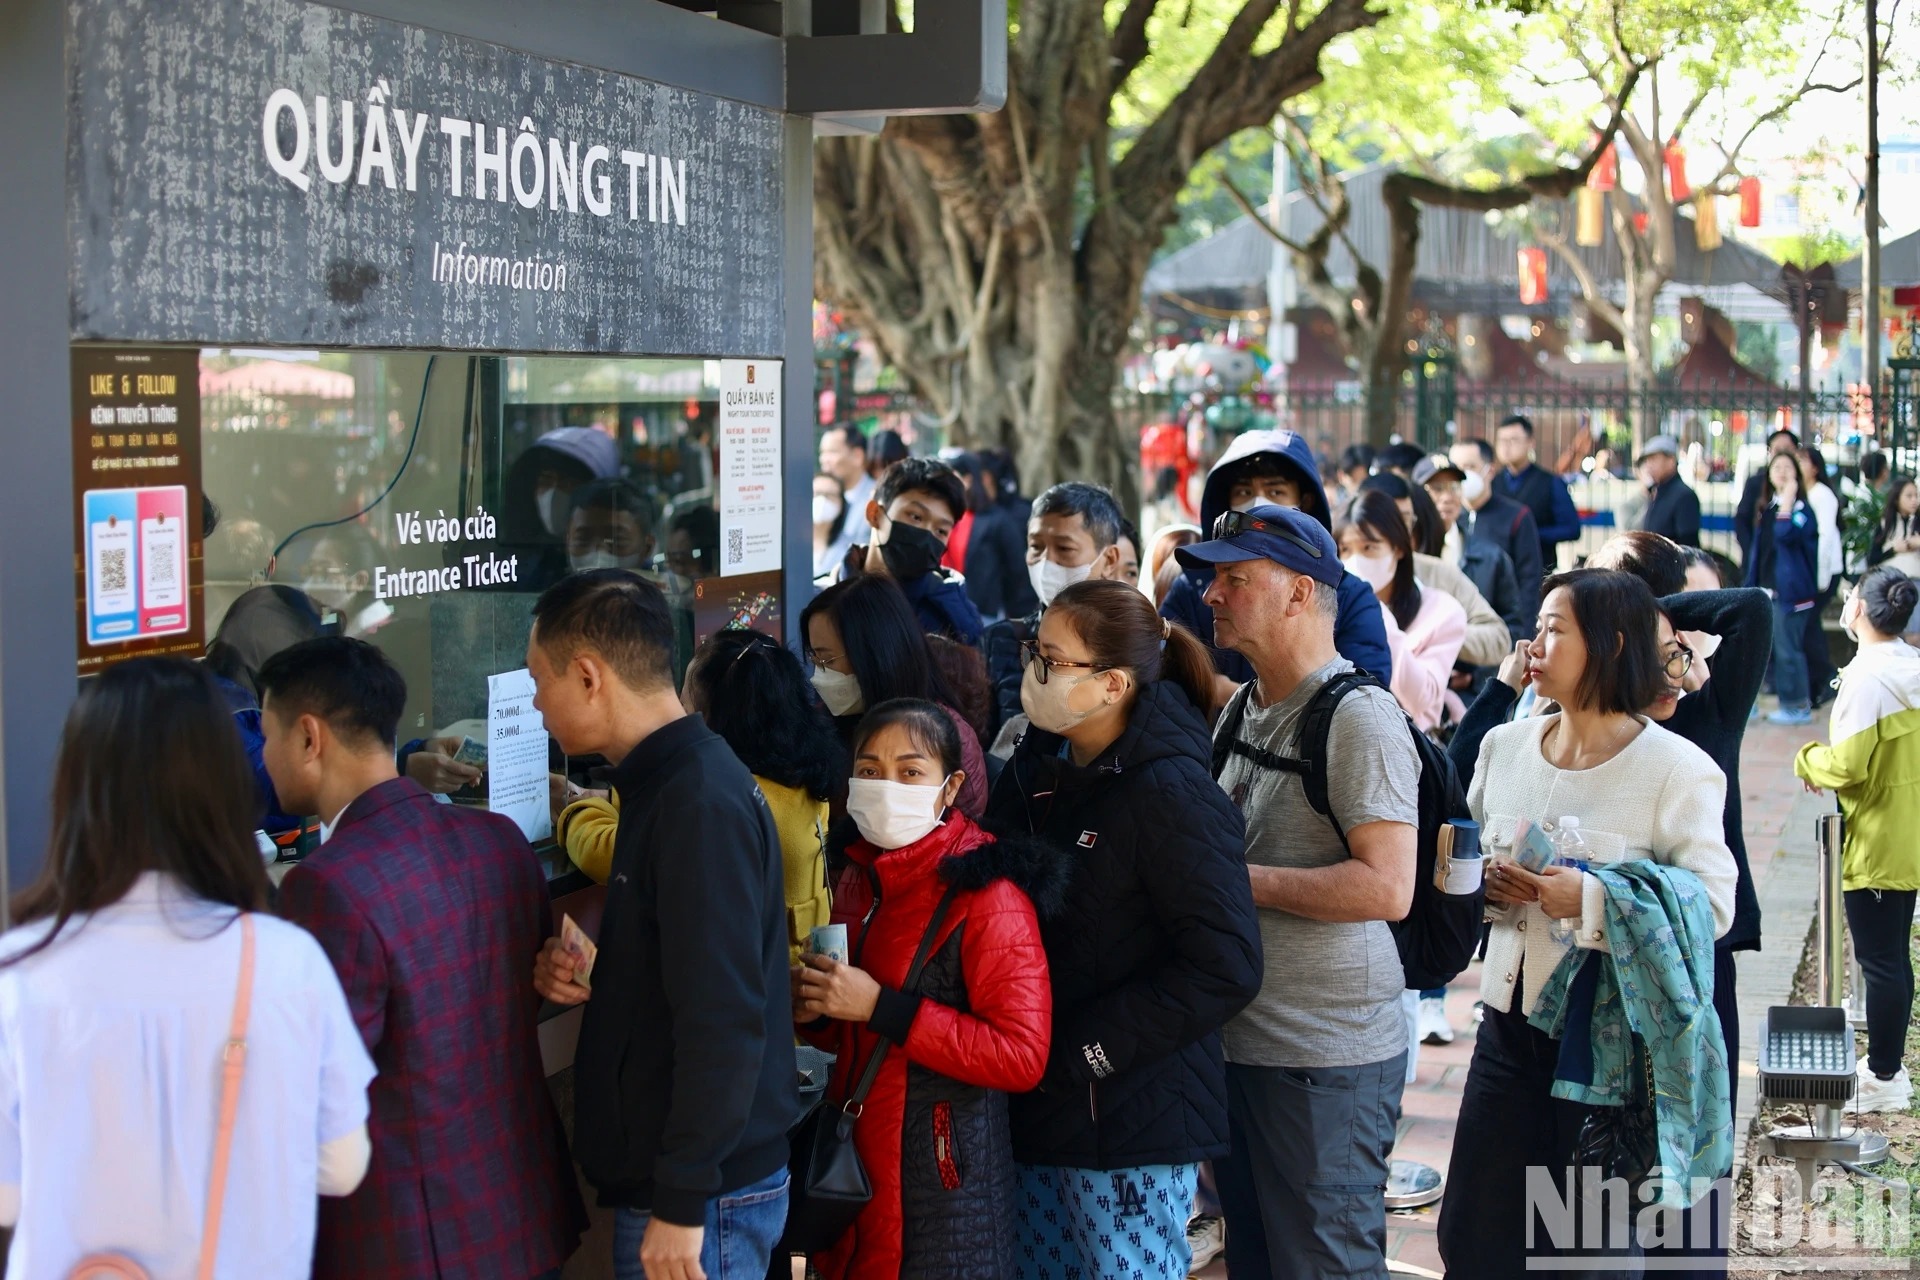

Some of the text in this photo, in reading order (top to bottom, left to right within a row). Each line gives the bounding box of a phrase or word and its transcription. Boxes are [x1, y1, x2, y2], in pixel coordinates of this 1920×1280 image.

[263, 80, 686, 226] QUẦY THÔNG TIN
[433, 241, 567, 292] Information
[90, 374, 176, 395] LIKE & FOLLOW
[90, 403, 115, 424] KÊNH
[150, 403, 177, 424] THÔNG
[396, 505, 496, 545] Vé vào cửa
[375, 552, 517, 599] Entrance Ticket
[1113, 1172, 1148, 1216] LA
